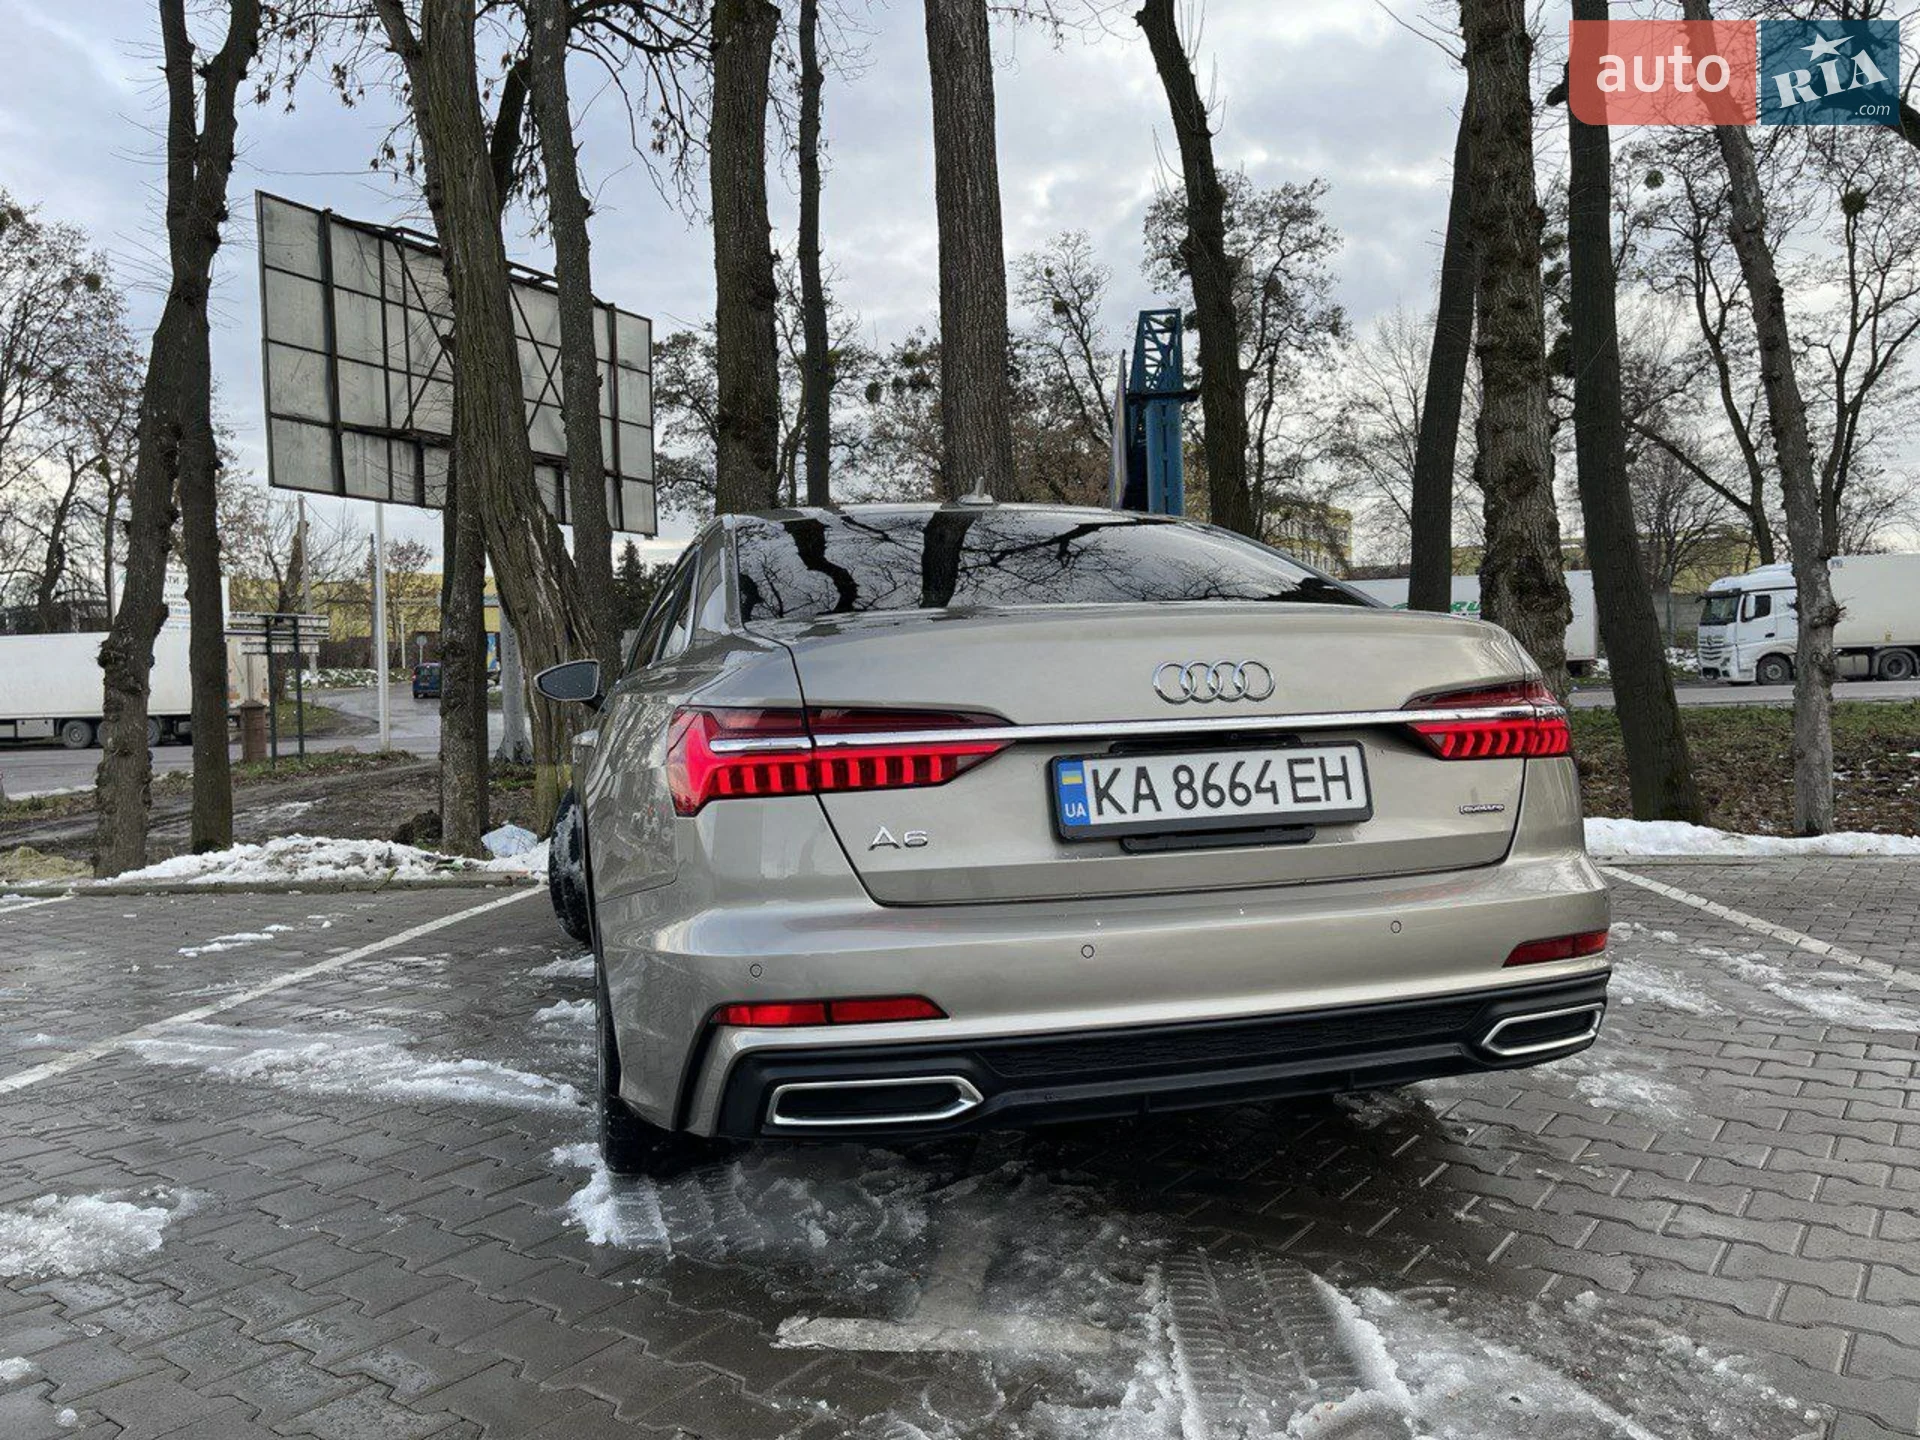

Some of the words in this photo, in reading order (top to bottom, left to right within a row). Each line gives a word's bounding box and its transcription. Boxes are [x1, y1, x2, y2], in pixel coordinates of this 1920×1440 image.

[1091, 766, 1162, 816] KA
[1172, 760, 1280, 811] 8664
[1287, 755, 1353, 805] EH
[1065, 803, 1087, 818] UA
[868, 826, 929, 851] A6
